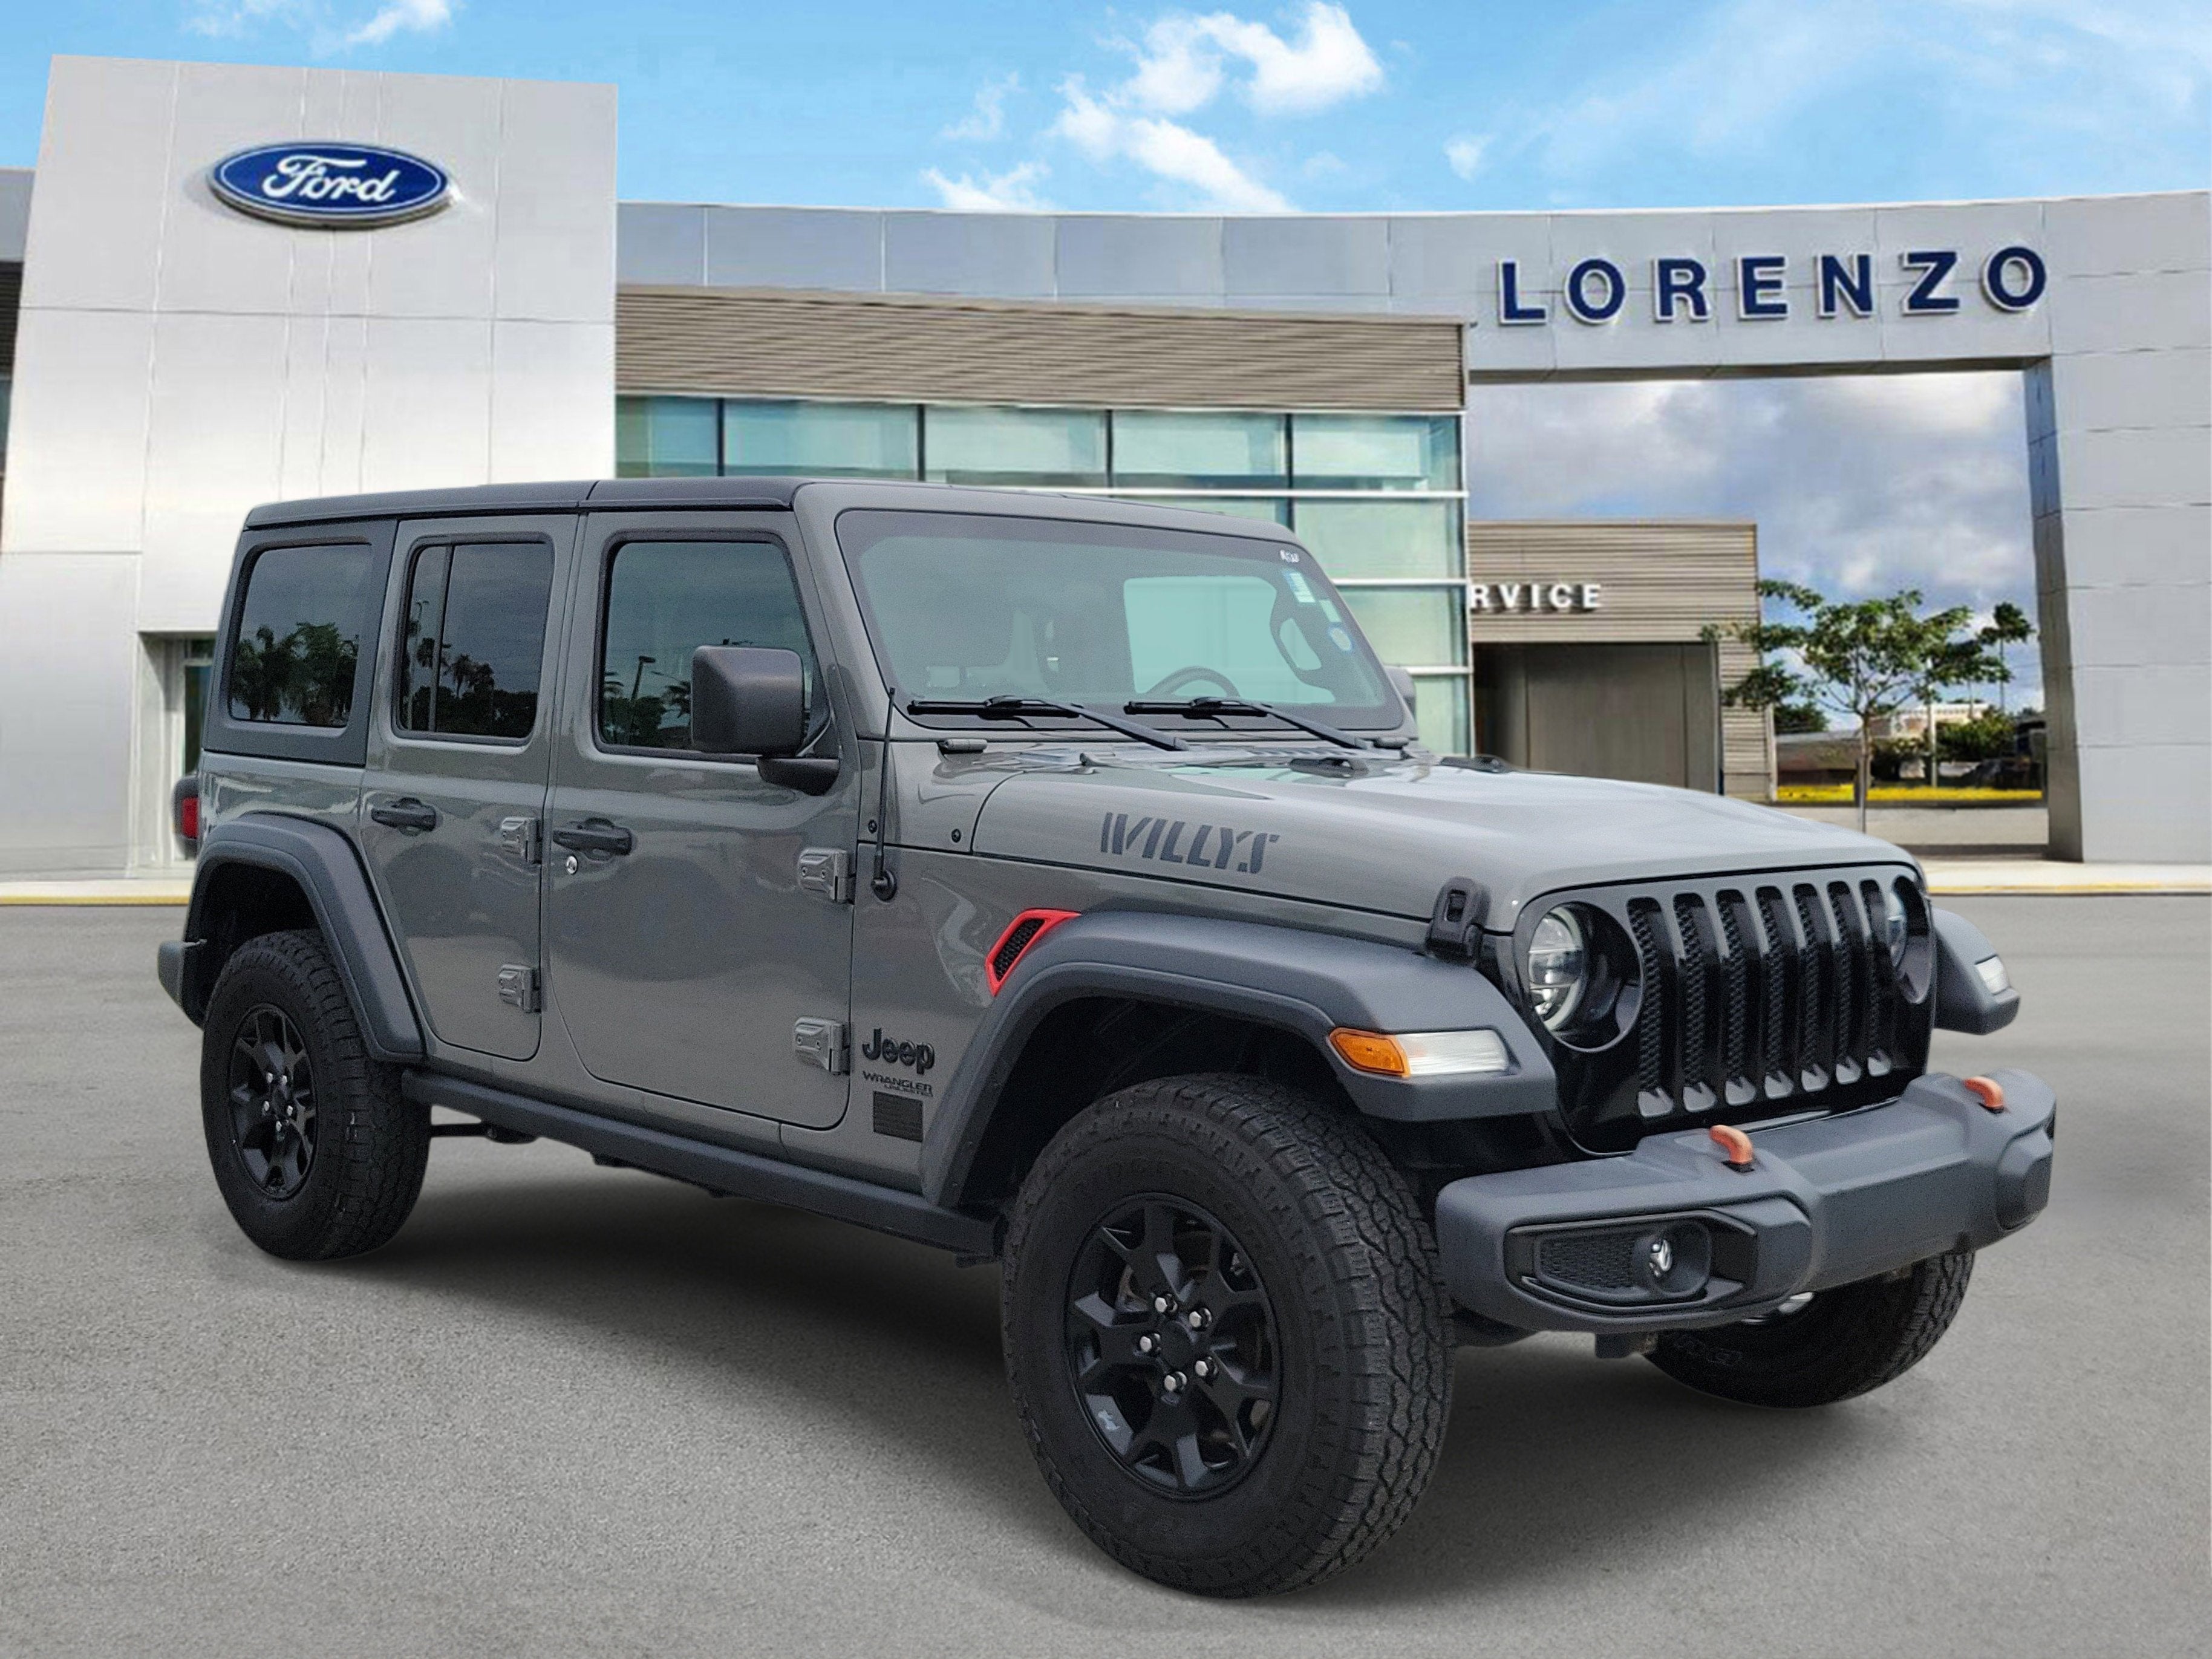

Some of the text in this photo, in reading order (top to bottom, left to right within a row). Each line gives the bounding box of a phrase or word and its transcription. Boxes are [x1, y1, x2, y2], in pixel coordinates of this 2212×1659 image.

[261, 155, 400, 202] Ford
[1497, 246, 2047, 324] LORENZO
[1470, 584, 1601, 608] RVICE
[1101, 812, 1280, 874] WILLYS
[862, 1028, 935, 1075] Jeep
[863, 1071, 932, 1094] WRANGLER
